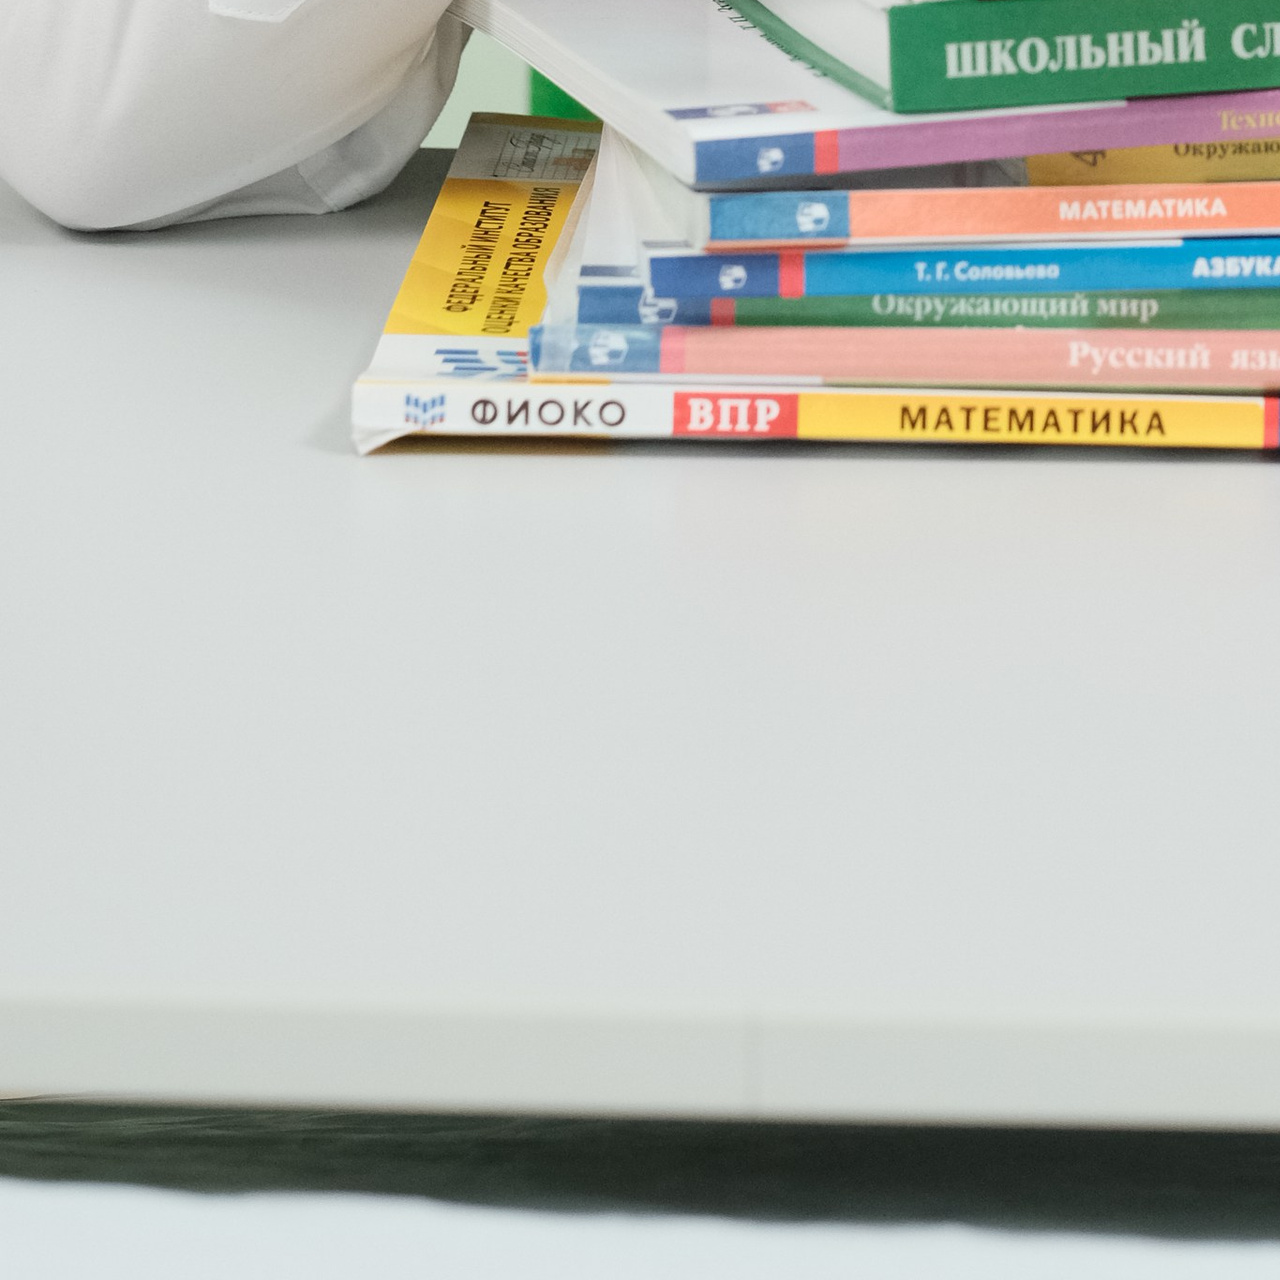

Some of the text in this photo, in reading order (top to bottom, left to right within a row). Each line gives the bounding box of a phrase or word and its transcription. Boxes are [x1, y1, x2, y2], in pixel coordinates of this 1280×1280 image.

[945, 20, 1206, 79] ШКОЛЬНЫЙ
[512, 187, 560, 250] ОБРАЗОВАНИЯ
[1059, 197, 1228, 221] МАТЕМАТИКА
[442, 200, 512, 313] ФЕДЕРАЛЬНЫЙ ИНСТИТУТ
[497, 251, 537, 295] КАЧЕСТВА
[915, 262, 930, 281] Т.
[481, 295, 523, 334] ОЦЕНКИ
[871, 292, 1089, 321] Окружающий
[1096, 295, 1159, 324] мир
[1068, 340, 1210, 375] Русский
[470, 397, 627, 428] ФИОКО
[686, 397, 782, 433] ВПР
[899, 403, 1166, 436] МАТЕМАТИКА
